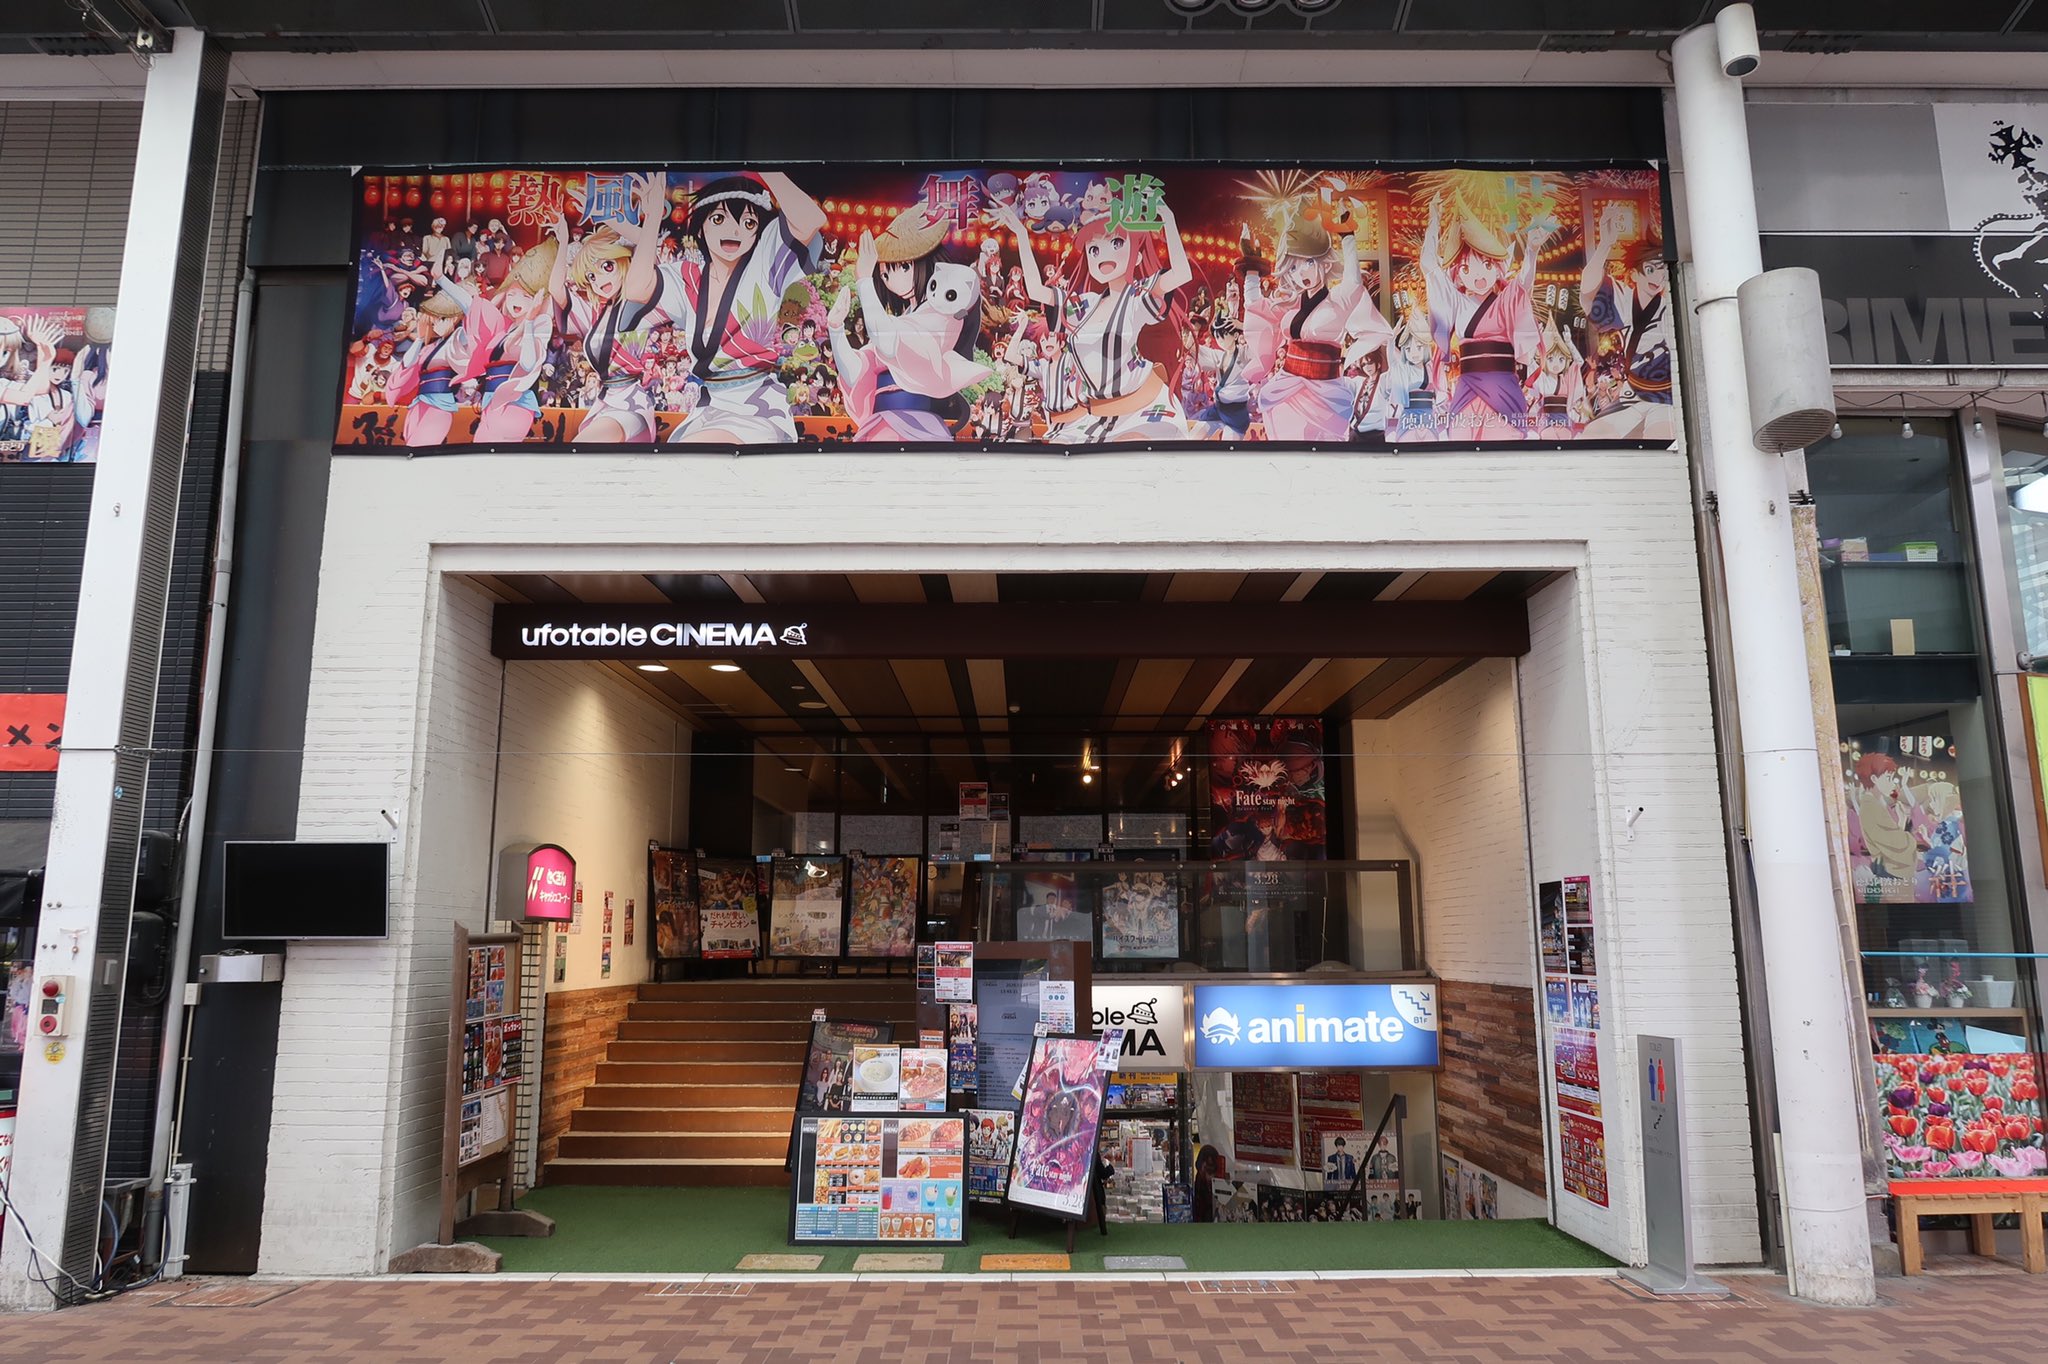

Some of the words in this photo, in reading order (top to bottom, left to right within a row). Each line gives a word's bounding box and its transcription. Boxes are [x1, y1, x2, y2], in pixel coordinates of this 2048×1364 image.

[577, 172, 643, 227] 風
[1104, 174, 1166, 233] 遊
[1401, 412, 1509, 429] 徳島阿波おどり
[521, 623, 647, 647] ufotable
[649, 622, 778, 647] CINEMA
[1235, 789, 1261, 807] Fate
[1262, 797, 1276, 808] stay
[1276, 795, 1295, 807] night
[1253, 874, 1280, 885] 3.28
[709, 920, 750, 929] チャンピオン
[1248, 1004, 1405, 1044] animate
